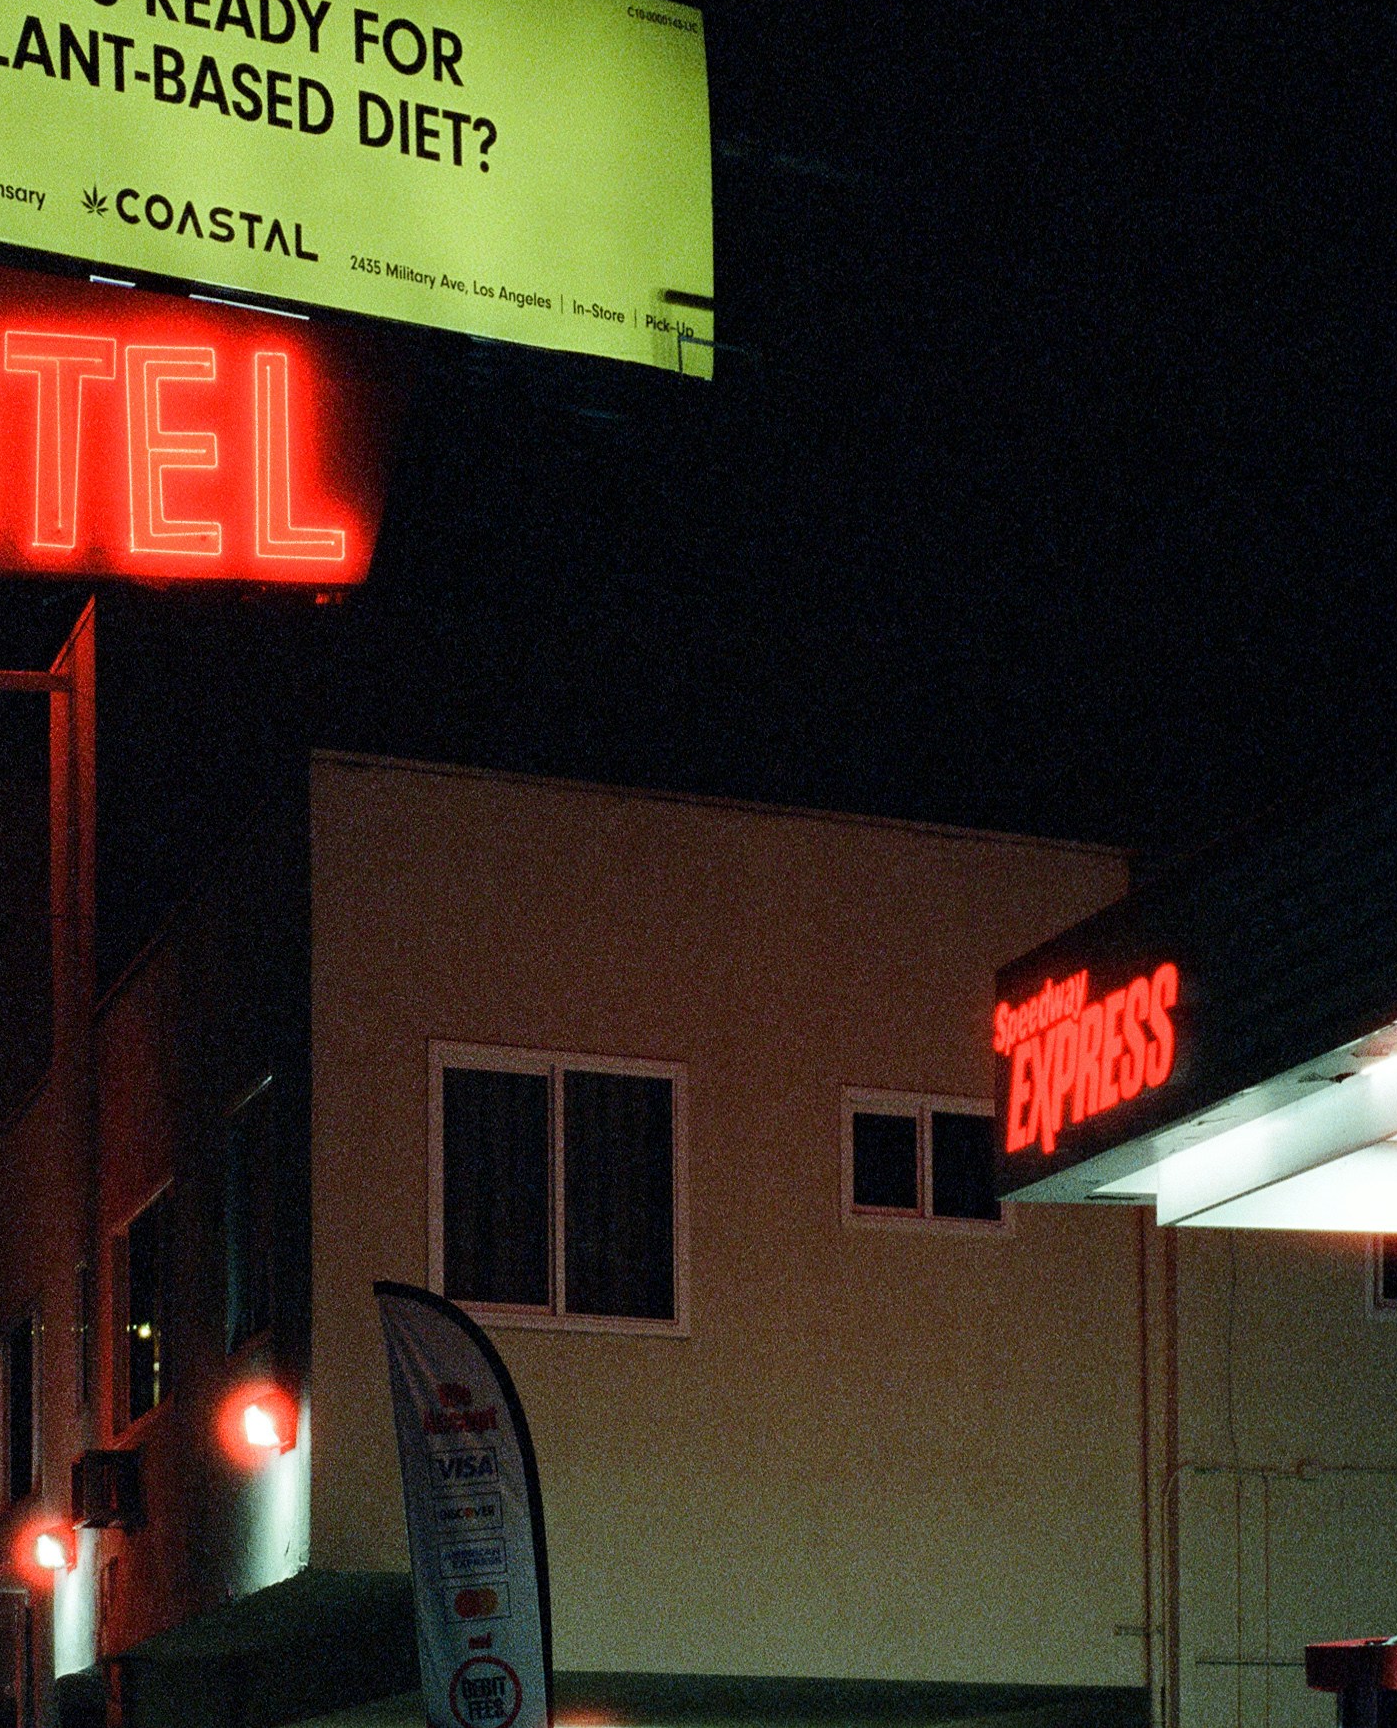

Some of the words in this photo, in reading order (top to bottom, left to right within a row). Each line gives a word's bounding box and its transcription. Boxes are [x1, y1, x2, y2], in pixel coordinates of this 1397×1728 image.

[354, 8, 464, 86] FOR
[359, 90, 497, 172] DIET?
[115, 188, 318, 262] COASTAL
[350, 255, 382, 275] 2435
[386, 262, 436, 289] Military
[440, 274, 469, 295] Ave,
[473, 280, 495, 298] Los
[498, 286, 552, 309] Angeles
[573, 300, 625, 323] In-Store
[645, 314, 694, 340] Pick-Up
[1006, 961, 1179, 1155] EXPRESS
[438, 1455, 495, 1479] VISA
[461, 1675, 507, 1700] DEBIT
[468, 1698, 507, 1723] FEES
